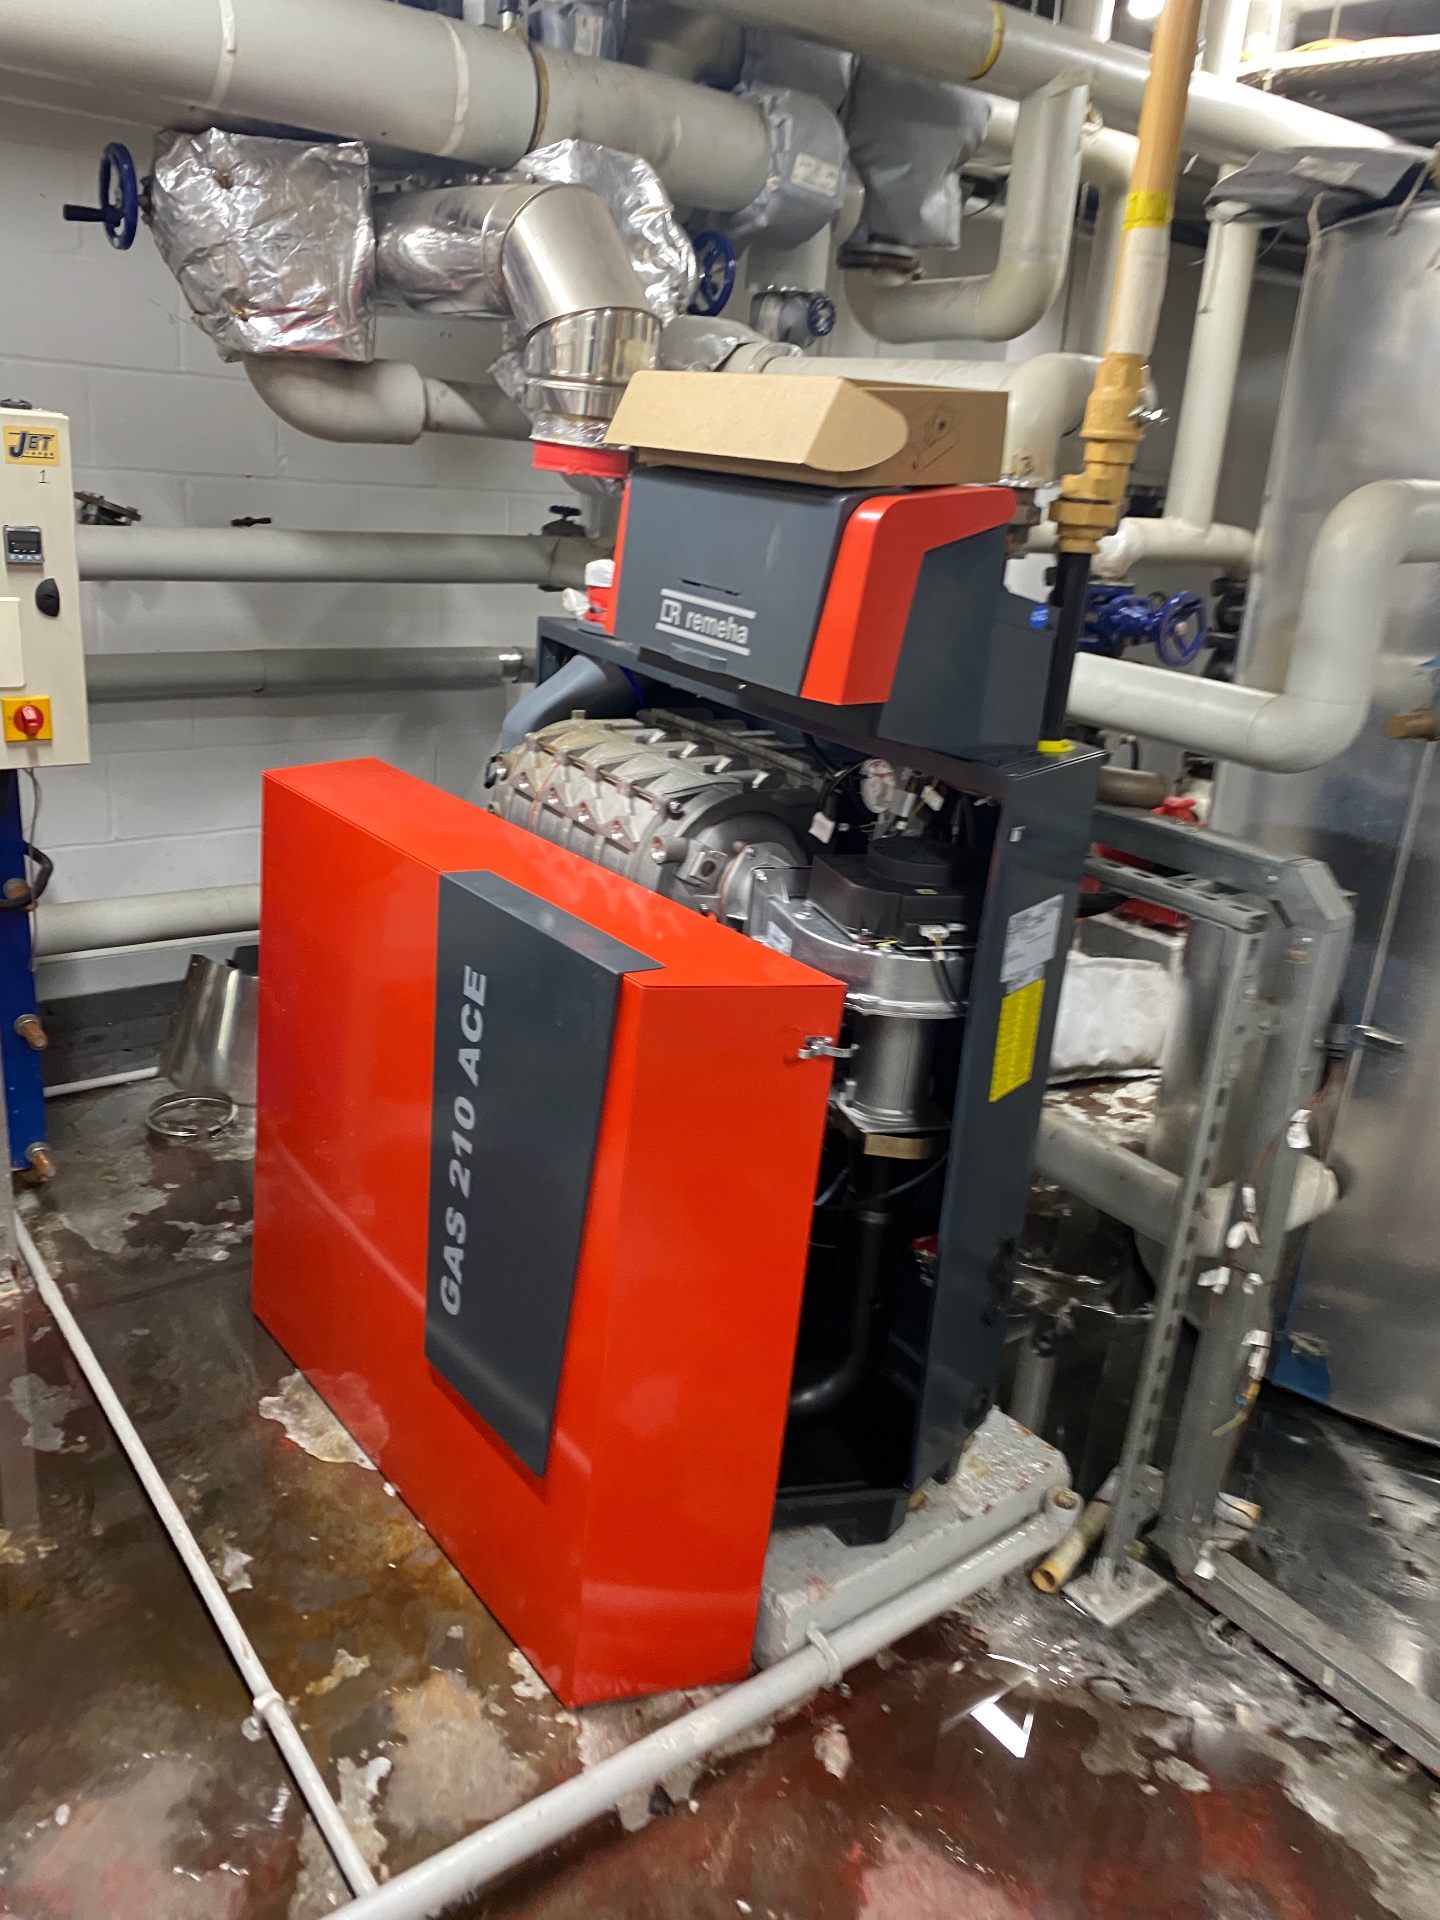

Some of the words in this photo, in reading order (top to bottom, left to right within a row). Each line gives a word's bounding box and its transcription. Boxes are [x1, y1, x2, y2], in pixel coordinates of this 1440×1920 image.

[9, 431, 52, 458] JET
[685, 611, 749, 644] remeha
[458, 964, 487, 1087] ACE
[449, 1096, 476, 1199] 210
[440, 1206, 467, 1316] GAS
